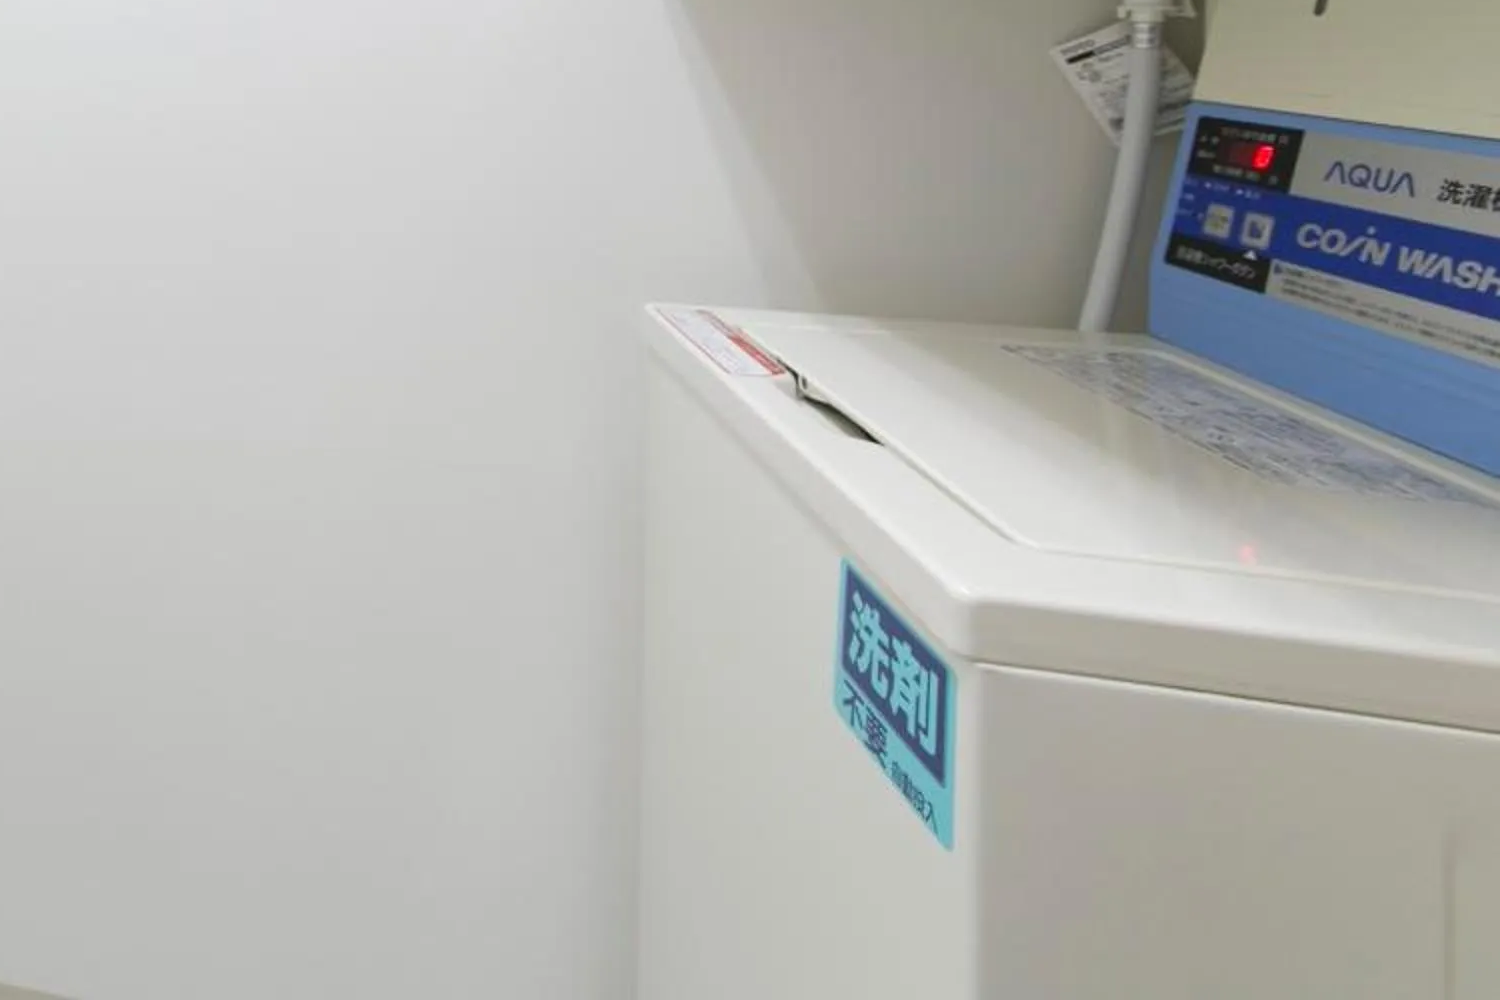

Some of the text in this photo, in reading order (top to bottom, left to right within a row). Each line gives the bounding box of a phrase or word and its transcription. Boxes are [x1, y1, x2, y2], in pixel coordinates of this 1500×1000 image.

[1252, 143, 1275, 170] 0
[1323, 160, 1415, 198] AQUA
[1296, 221, 1500, 297] COIN WASH
[848, 589, 940, 756] 洗剤
[842, 679, 889, 769] 不要
